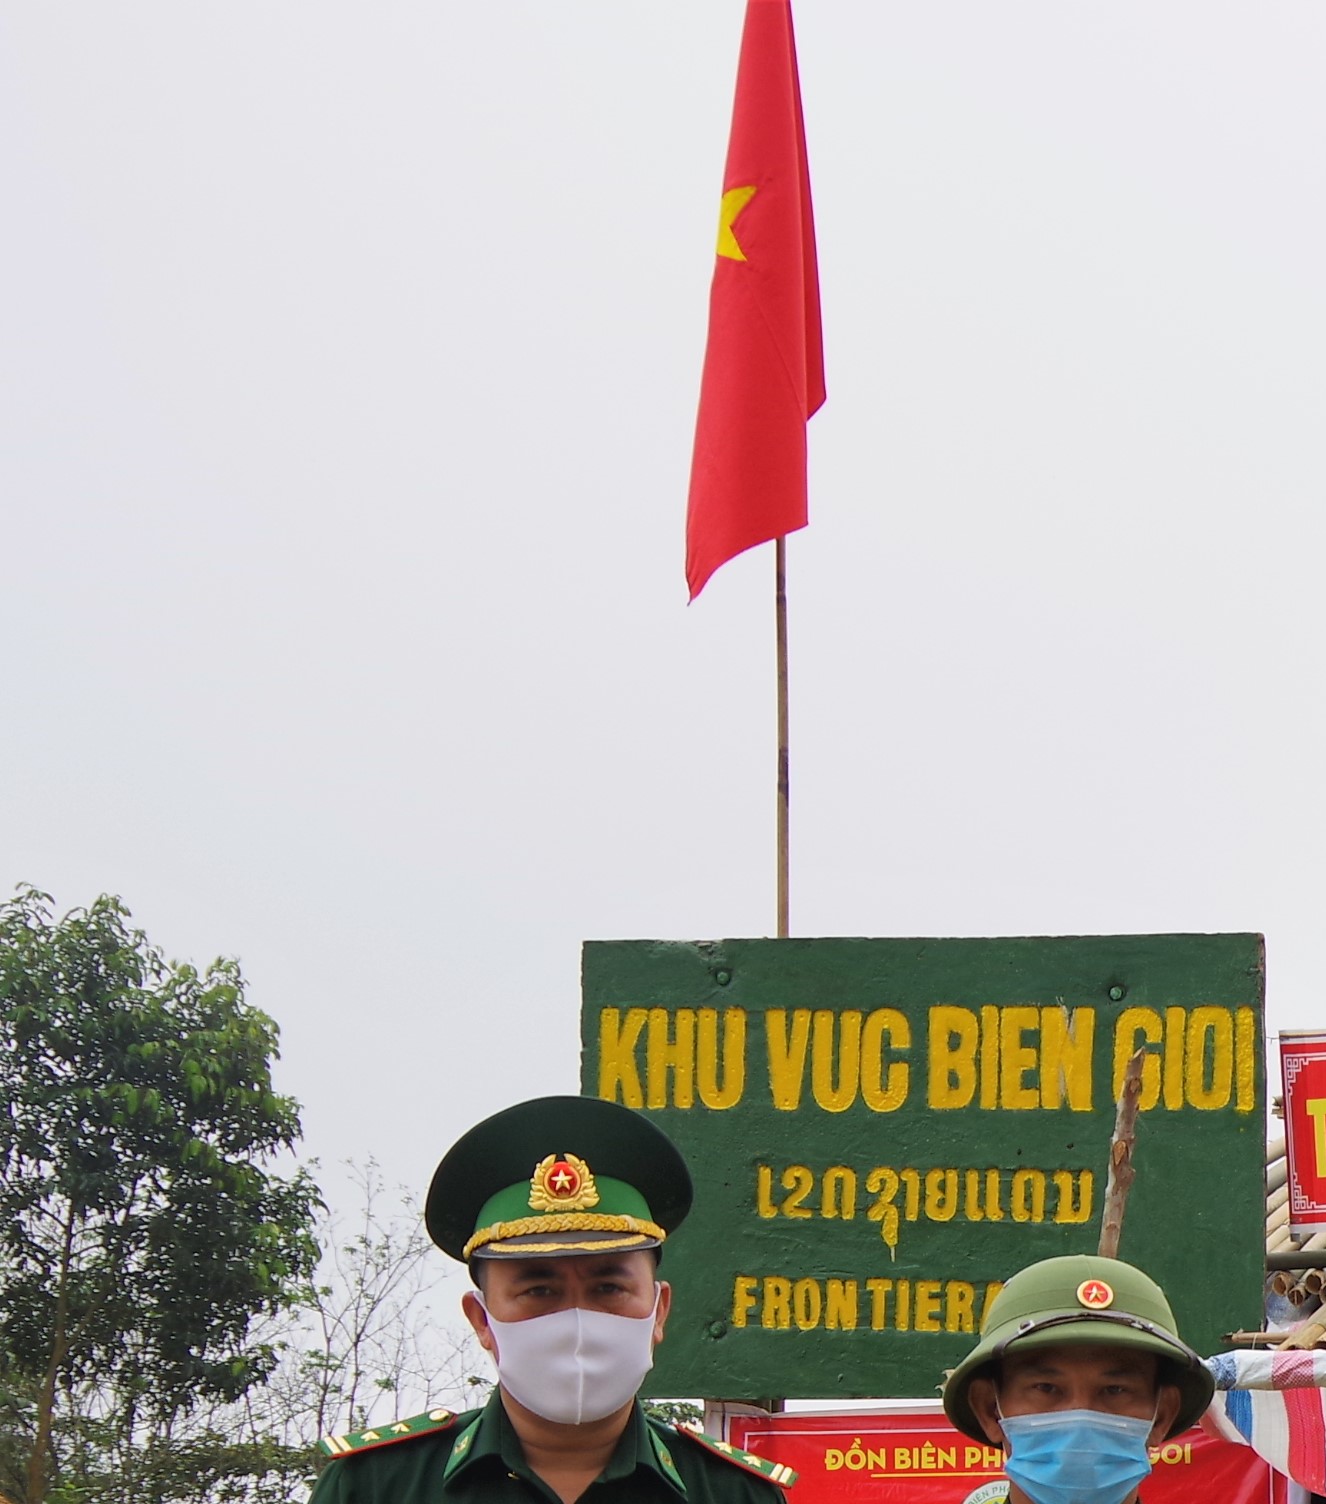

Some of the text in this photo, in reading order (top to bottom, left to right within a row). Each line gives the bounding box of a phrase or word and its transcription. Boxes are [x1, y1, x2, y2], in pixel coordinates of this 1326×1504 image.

[600, 1004, 1255, 1113] KHU VUC BIEN GIOI
[731, 1275, 976, 1334] FRONTIER
[824, 1437, 886, 1472] ĐỒN
[894, 1441, 957, 1471] BIÊN
[965, 1445, 1009, 1471] PH
